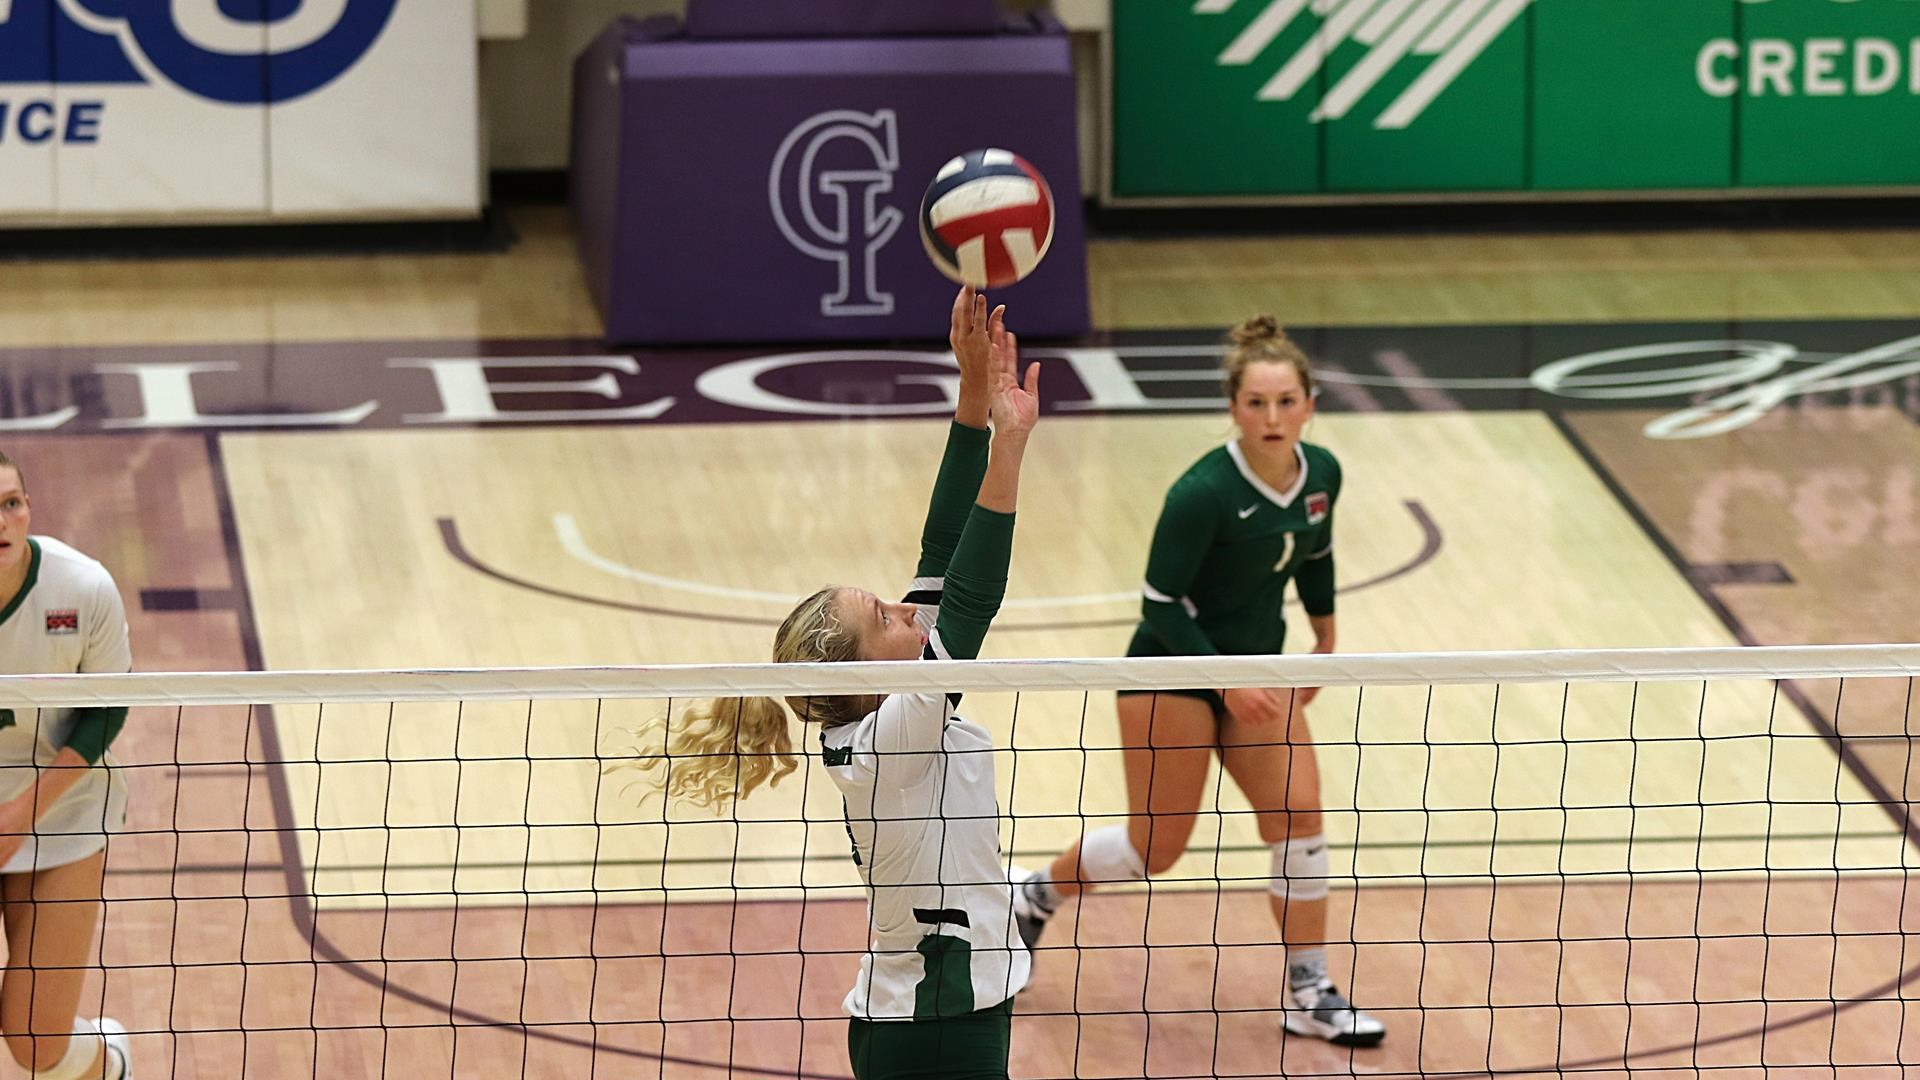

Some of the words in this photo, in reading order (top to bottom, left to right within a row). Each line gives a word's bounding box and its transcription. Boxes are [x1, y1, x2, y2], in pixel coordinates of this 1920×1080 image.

[1695, 37, 1920, 97] CREDI
[0, 345, 1233, 432] LEGE
[1273, 531, 1296, 573] 1
